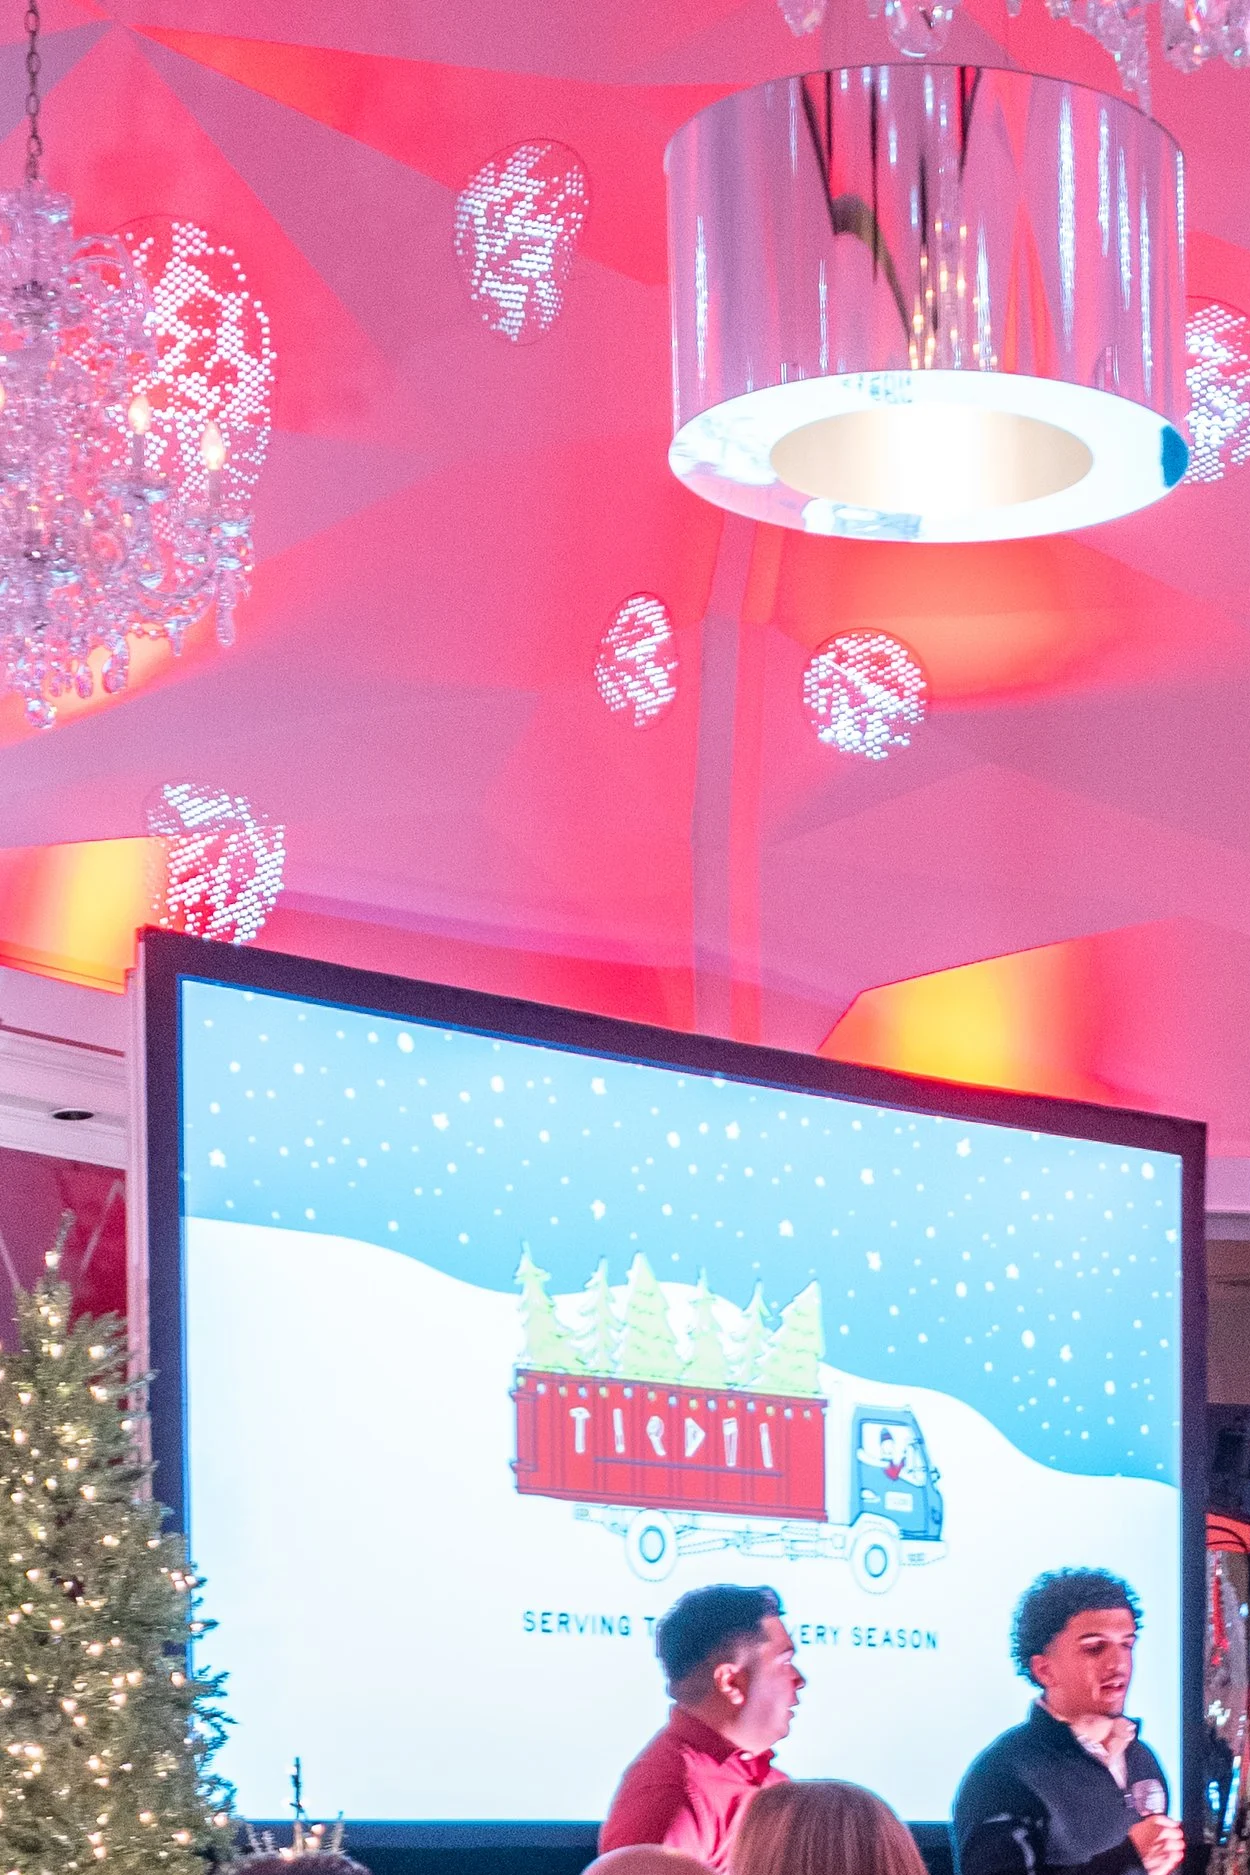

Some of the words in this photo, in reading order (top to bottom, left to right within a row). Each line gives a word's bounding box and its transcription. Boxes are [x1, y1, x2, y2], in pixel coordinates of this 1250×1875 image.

[522, 1610, 631, 1637] SERVING
[788, 1623, 840, 1645] ERY
[851, 1625, 939, 1649] SEASON
